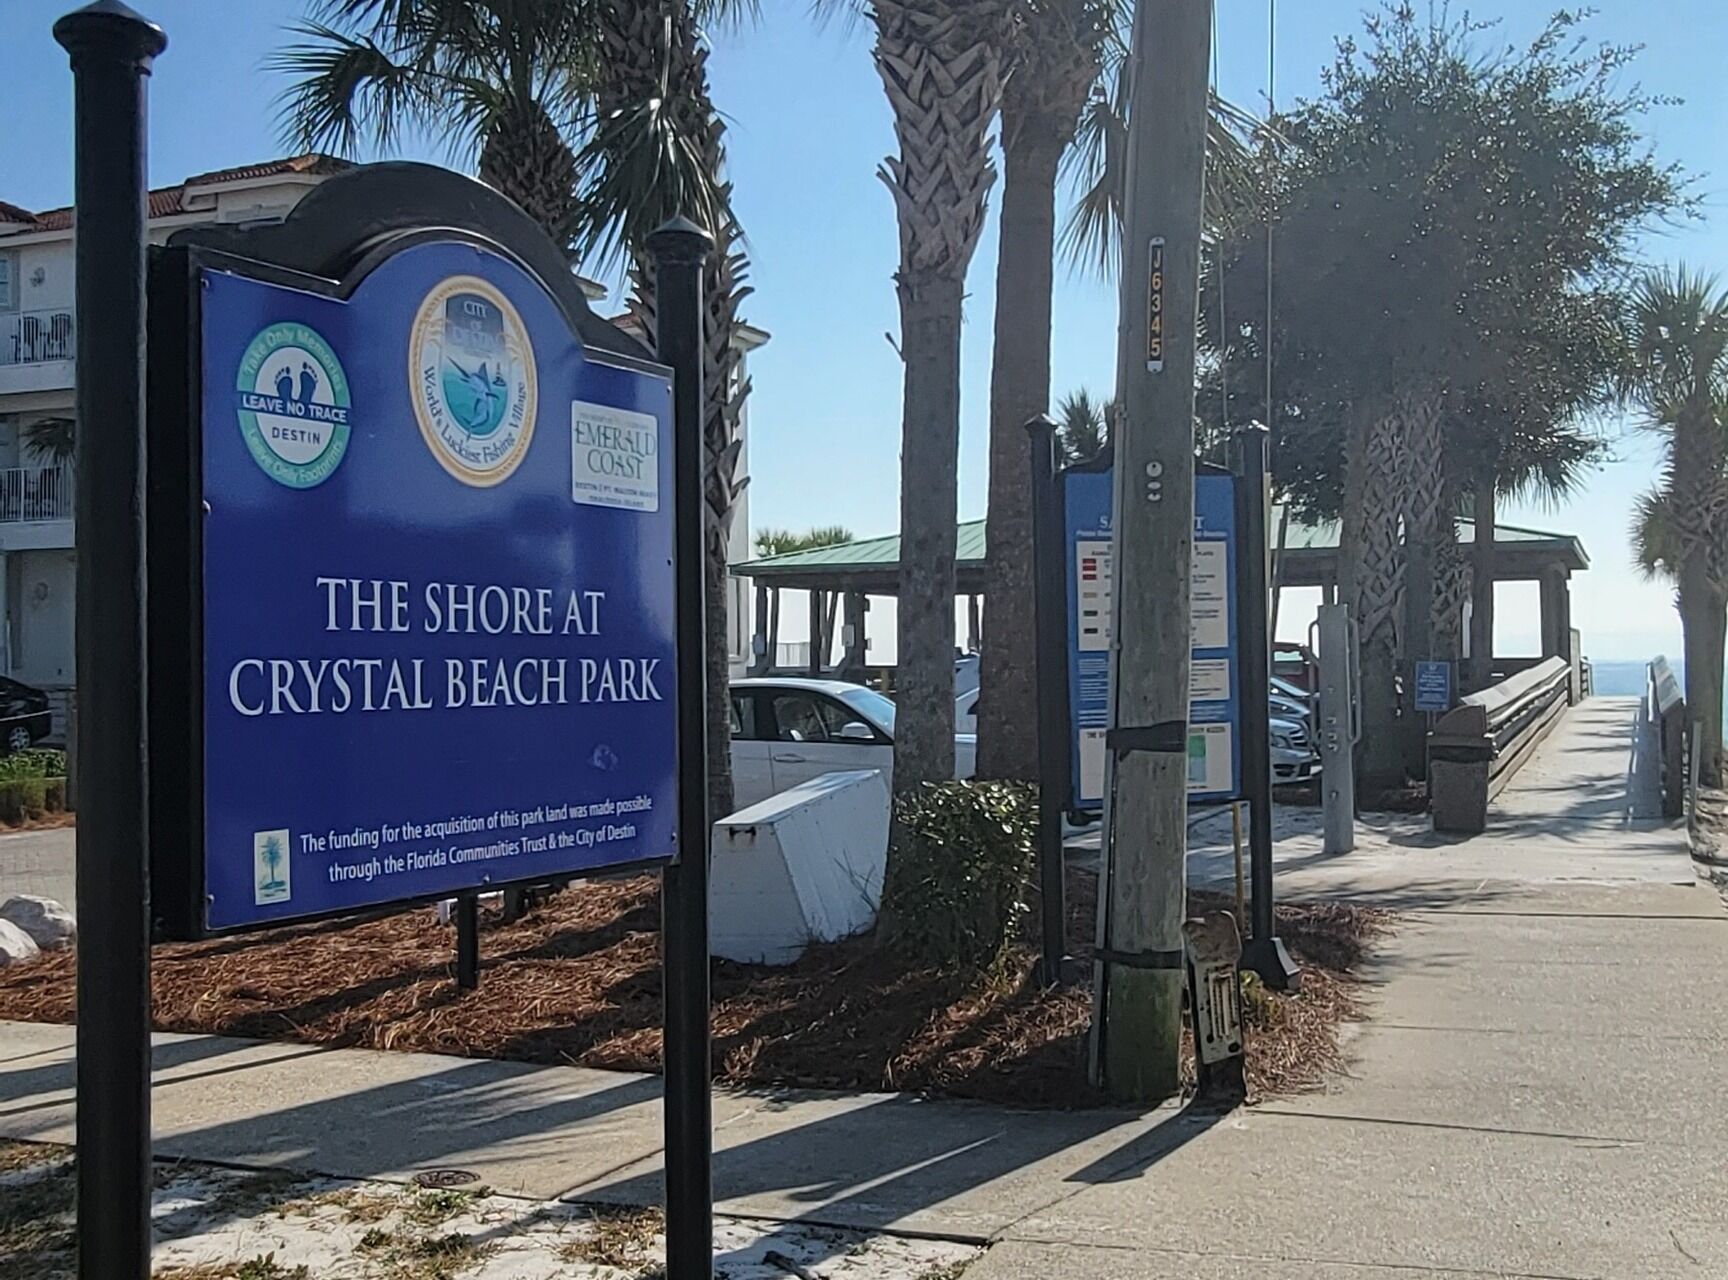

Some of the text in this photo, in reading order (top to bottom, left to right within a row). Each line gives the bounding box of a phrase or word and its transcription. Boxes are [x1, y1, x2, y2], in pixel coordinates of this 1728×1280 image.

[1150, 248, 1162, 357] J6345
[243, 342, 268, 376] Take
[265, 328, 294, 347] Only
[242, 394, 347, 423] LEAVE NO TRACE
[272, 427, 321, 444] DESTIN
[424, 366, 442, 428] World's
[482, 433, 516, 464] Fishing
[574, 420, 656, 458] EMERALD
[587, 449, 644, 480] COAST
[316, 577, 605, 635] THE SHORE AT
[229, 658, 663, 716] CRYSTAL BEACH PARK
[300, 794, 652, 854] The funding for the acquisition of this park land was made possible
[328, 823, 636, 882] through the Florida Communities Trust & the City of Destin
